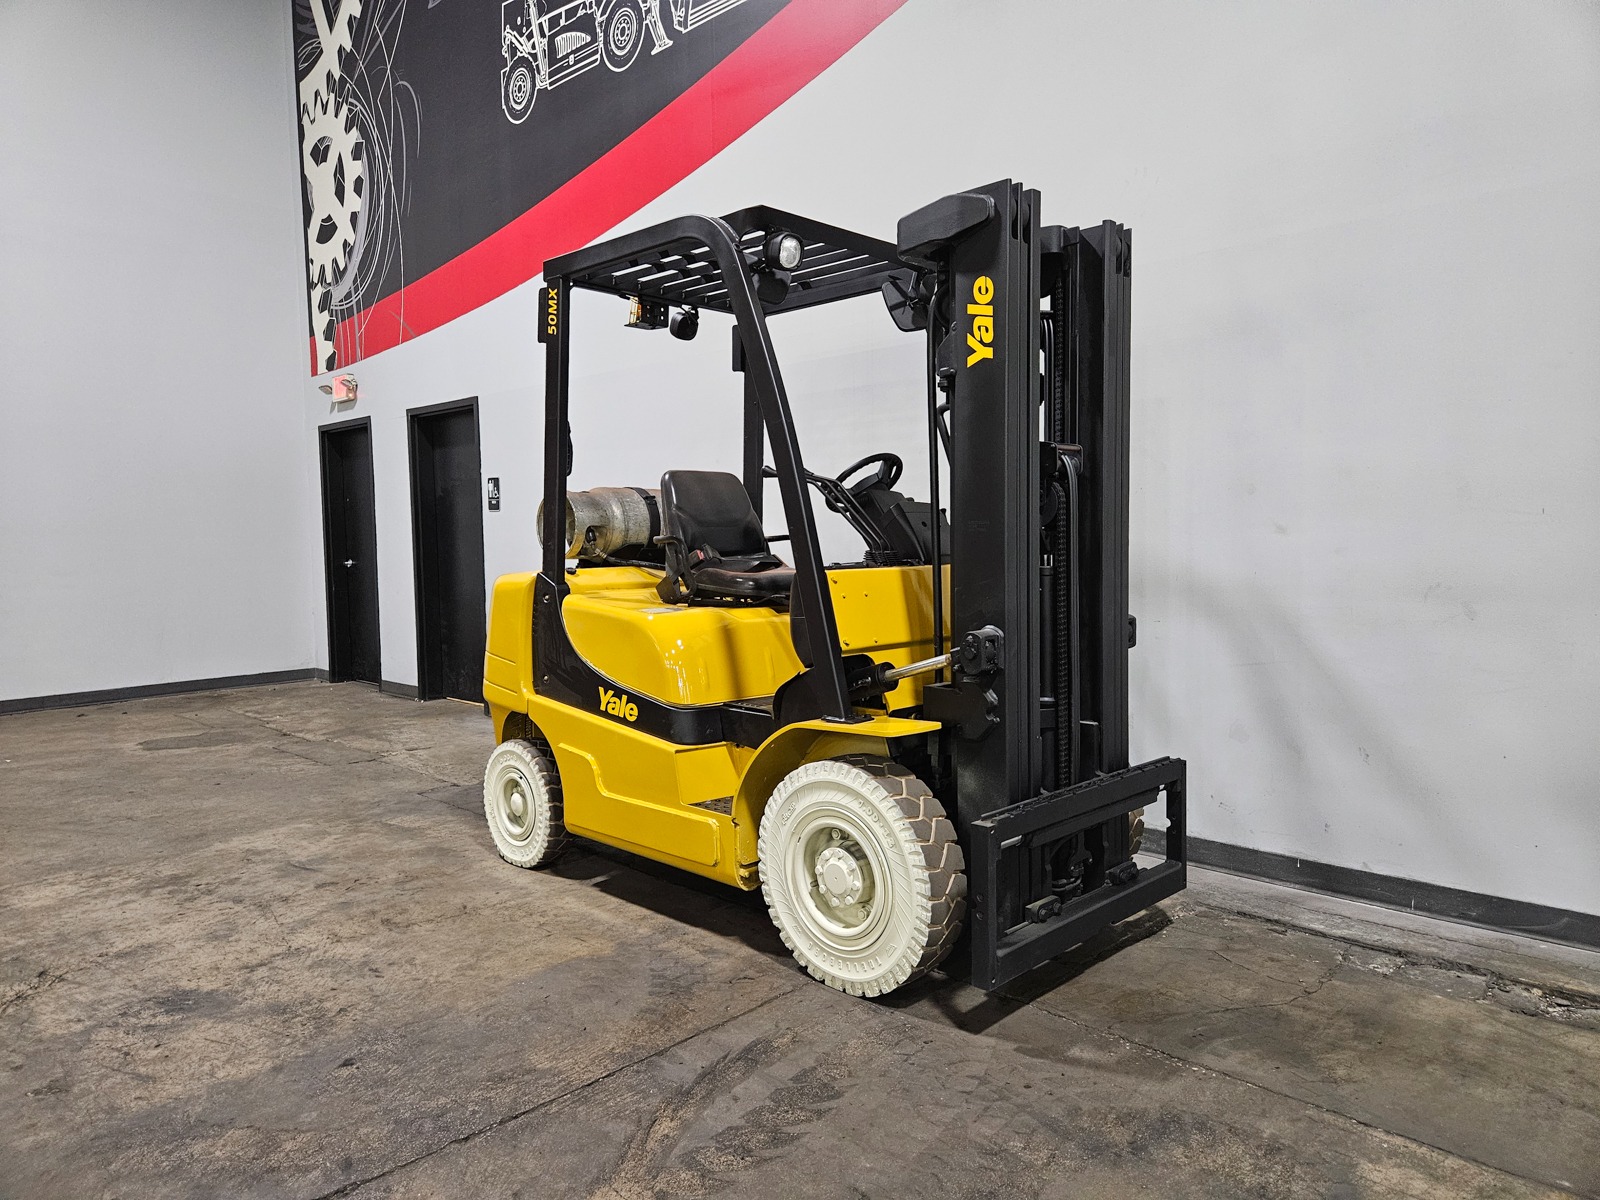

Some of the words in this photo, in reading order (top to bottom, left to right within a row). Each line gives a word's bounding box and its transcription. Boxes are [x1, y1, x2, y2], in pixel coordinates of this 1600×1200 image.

[547, 287, 558, 336] 50MX
[966, 275, 995, 368] Yale
[598, 686, 639, 722] Yale
